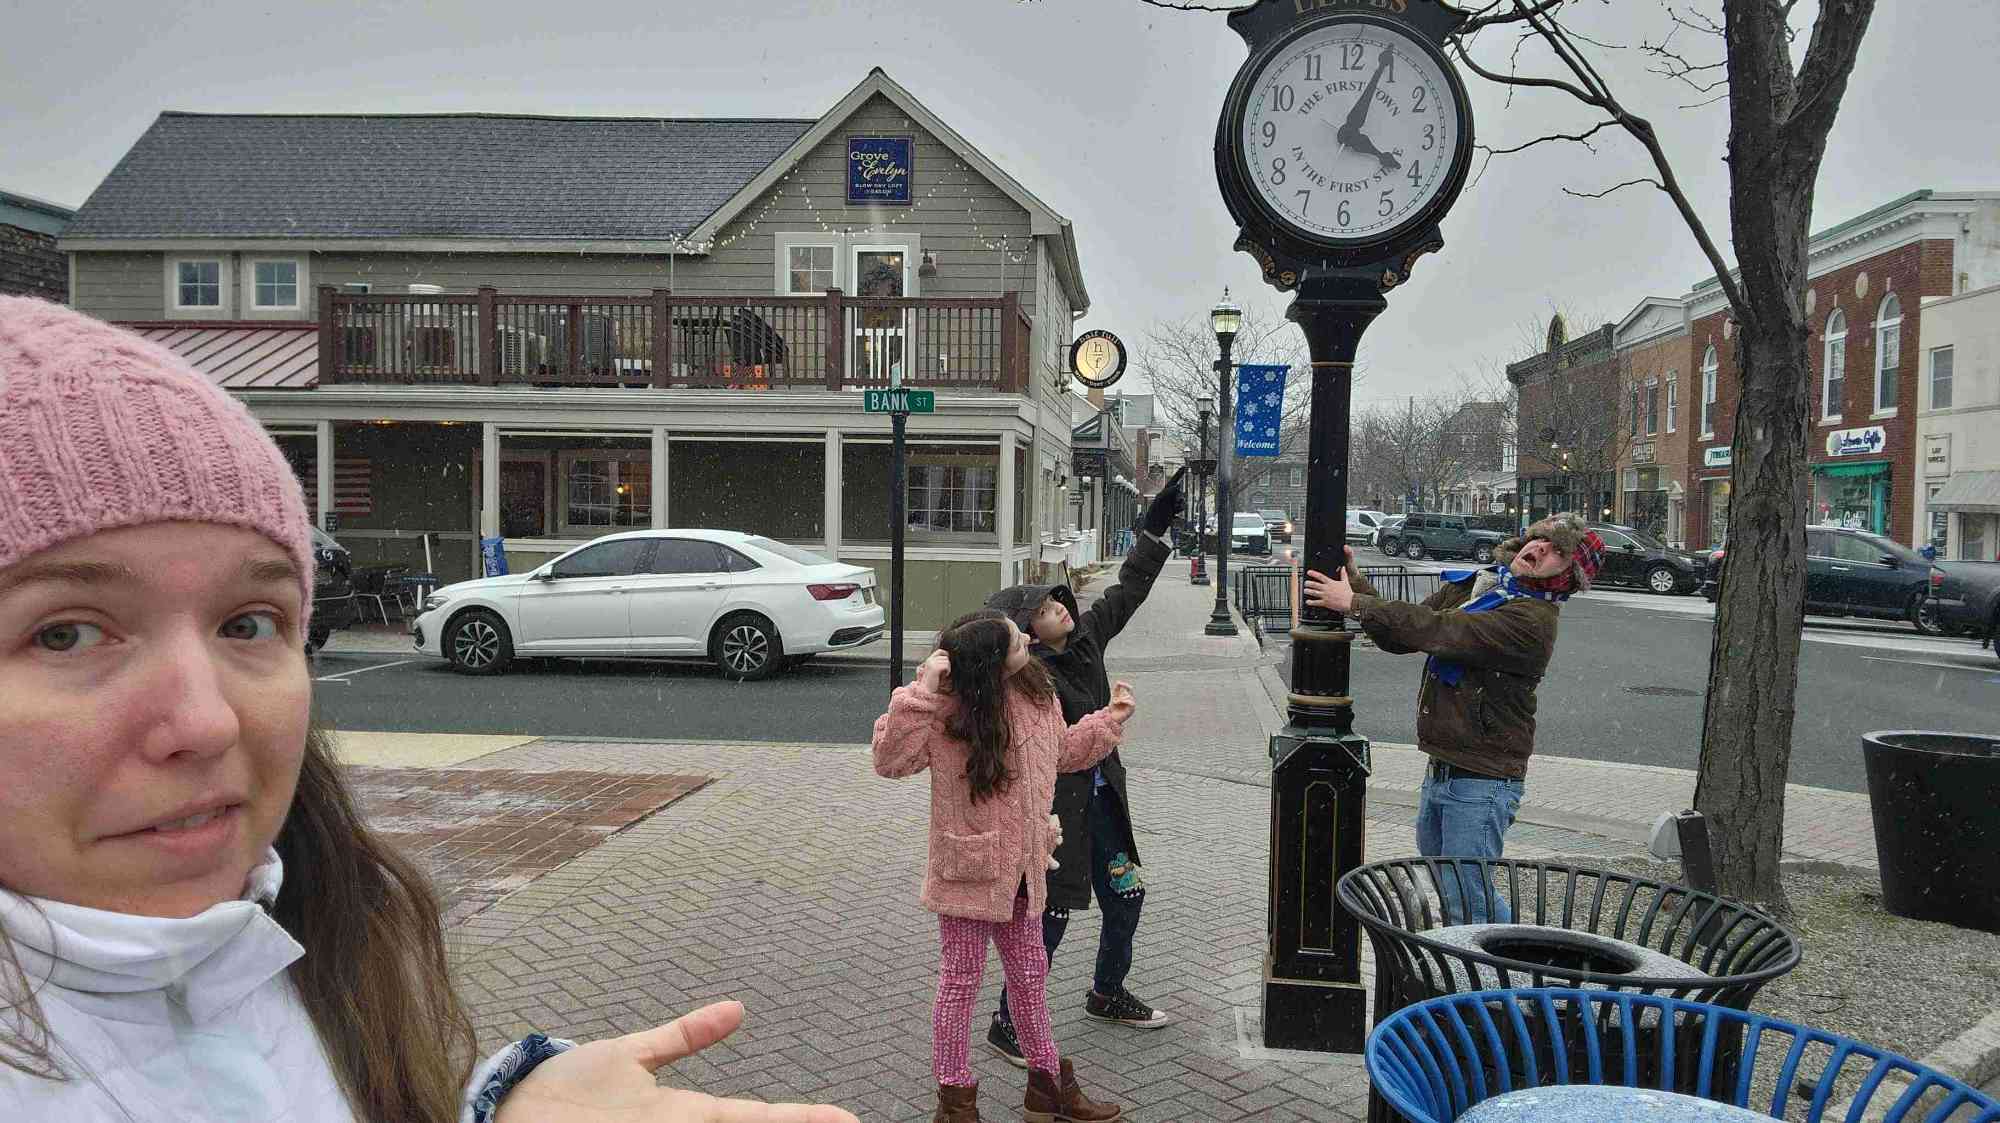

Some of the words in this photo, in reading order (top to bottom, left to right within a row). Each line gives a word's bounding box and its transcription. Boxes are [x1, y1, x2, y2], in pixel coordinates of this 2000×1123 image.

[1304, 53, 1323, 81] 11
[1340, 44, 1365, 70] 12
[1272, 85, 1295, 112] 10
[1298, 90, 1325, 116] THE
[1325, 80, 1368, 95] FIRST
[1373, 86, 1401, 117] OWN
[1411, 86, 1427, 113] 2
[1262, 121, 1277, 148] 9
[1421, 123, 1435, 151] 3
[851, 151, 889, 161] Grove
[1291, 145, 1305, 162] IN
[1301, 162, 1327, 187] THE
[1329, 178, 1371, 193] FIRST
[1372, 147, 1404, 183] STE
[862, 160, 908, 182] Evelyn
[1270, 157, 1287, 186] 8
[1406, 159, 1423, 188] 4
[1295, 189, 1312, 217] 7
[1336, 200, 1351, 227] 6
[1378, 188, 1395, 217] 5
[871, 392, 910, 411] BANK
[916, 397, 929, 408] ST
[1237, 439, 1276, 449] Welcome
